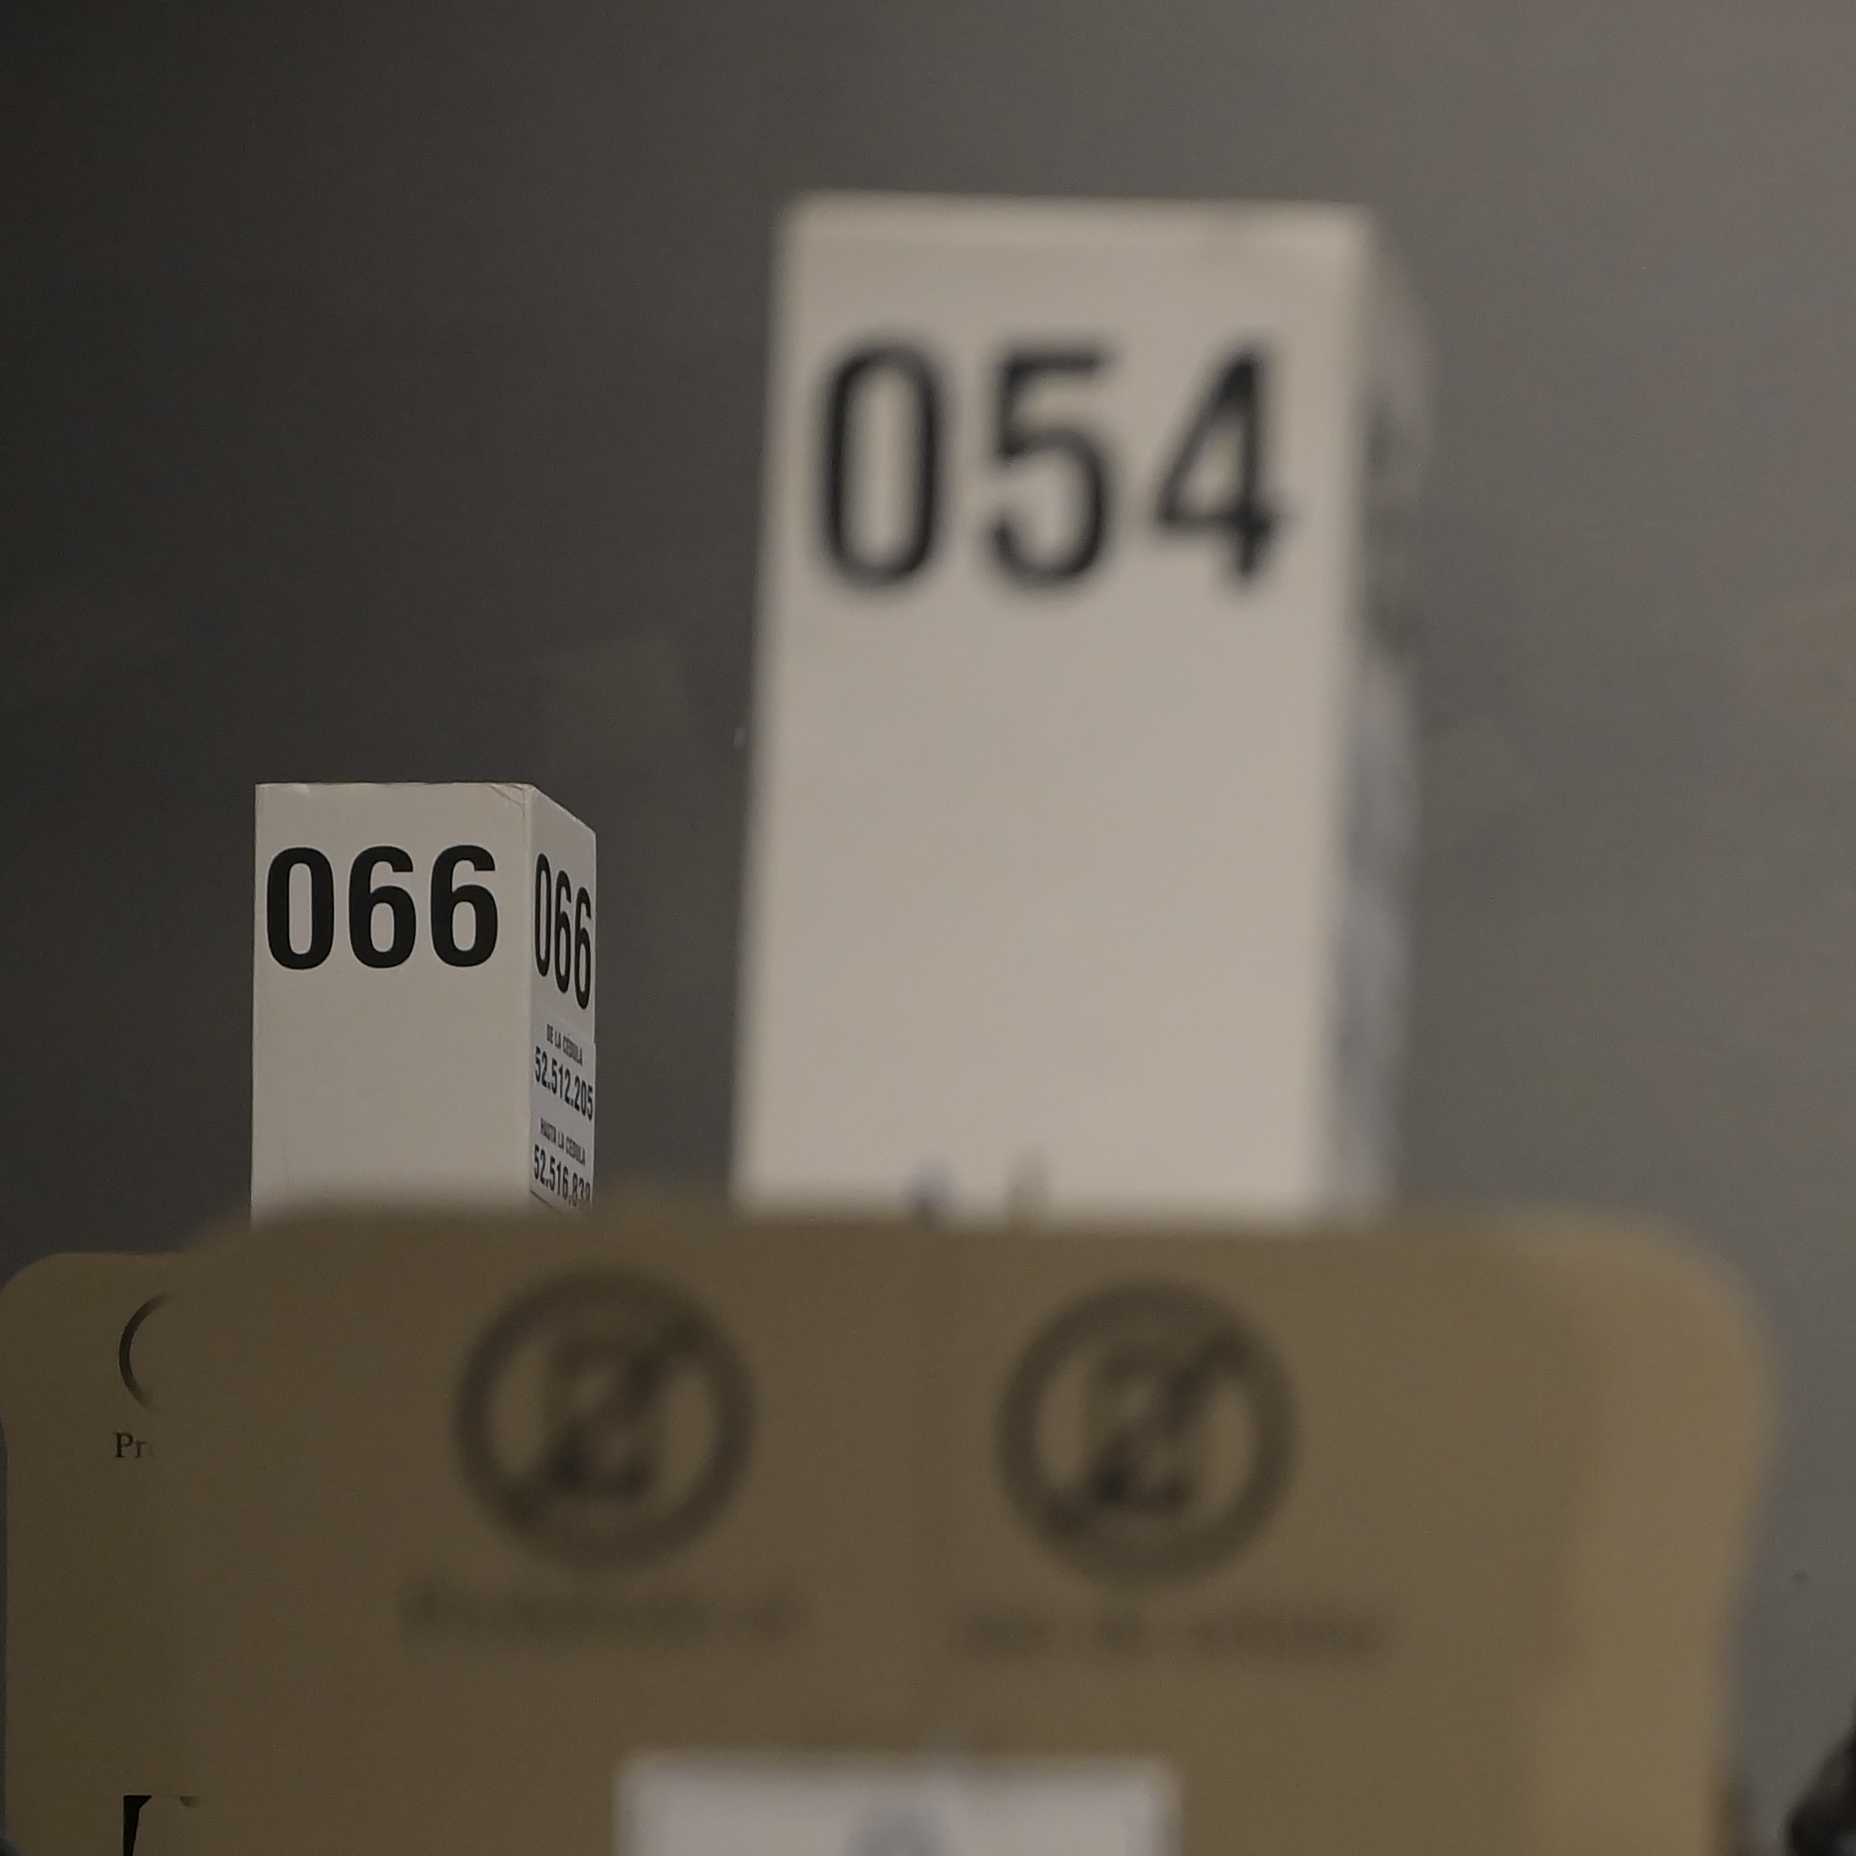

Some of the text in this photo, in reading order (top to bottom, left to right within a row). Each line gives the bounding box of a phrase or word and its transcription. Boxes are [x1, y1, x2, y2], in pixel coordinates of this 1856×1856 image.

[820, 336, 1287, 592] 054
[266, 845, 499, 969] 066
[535, 853, 593, 1009] 066
[535, 1046, 593, 1121] 52.512.205
